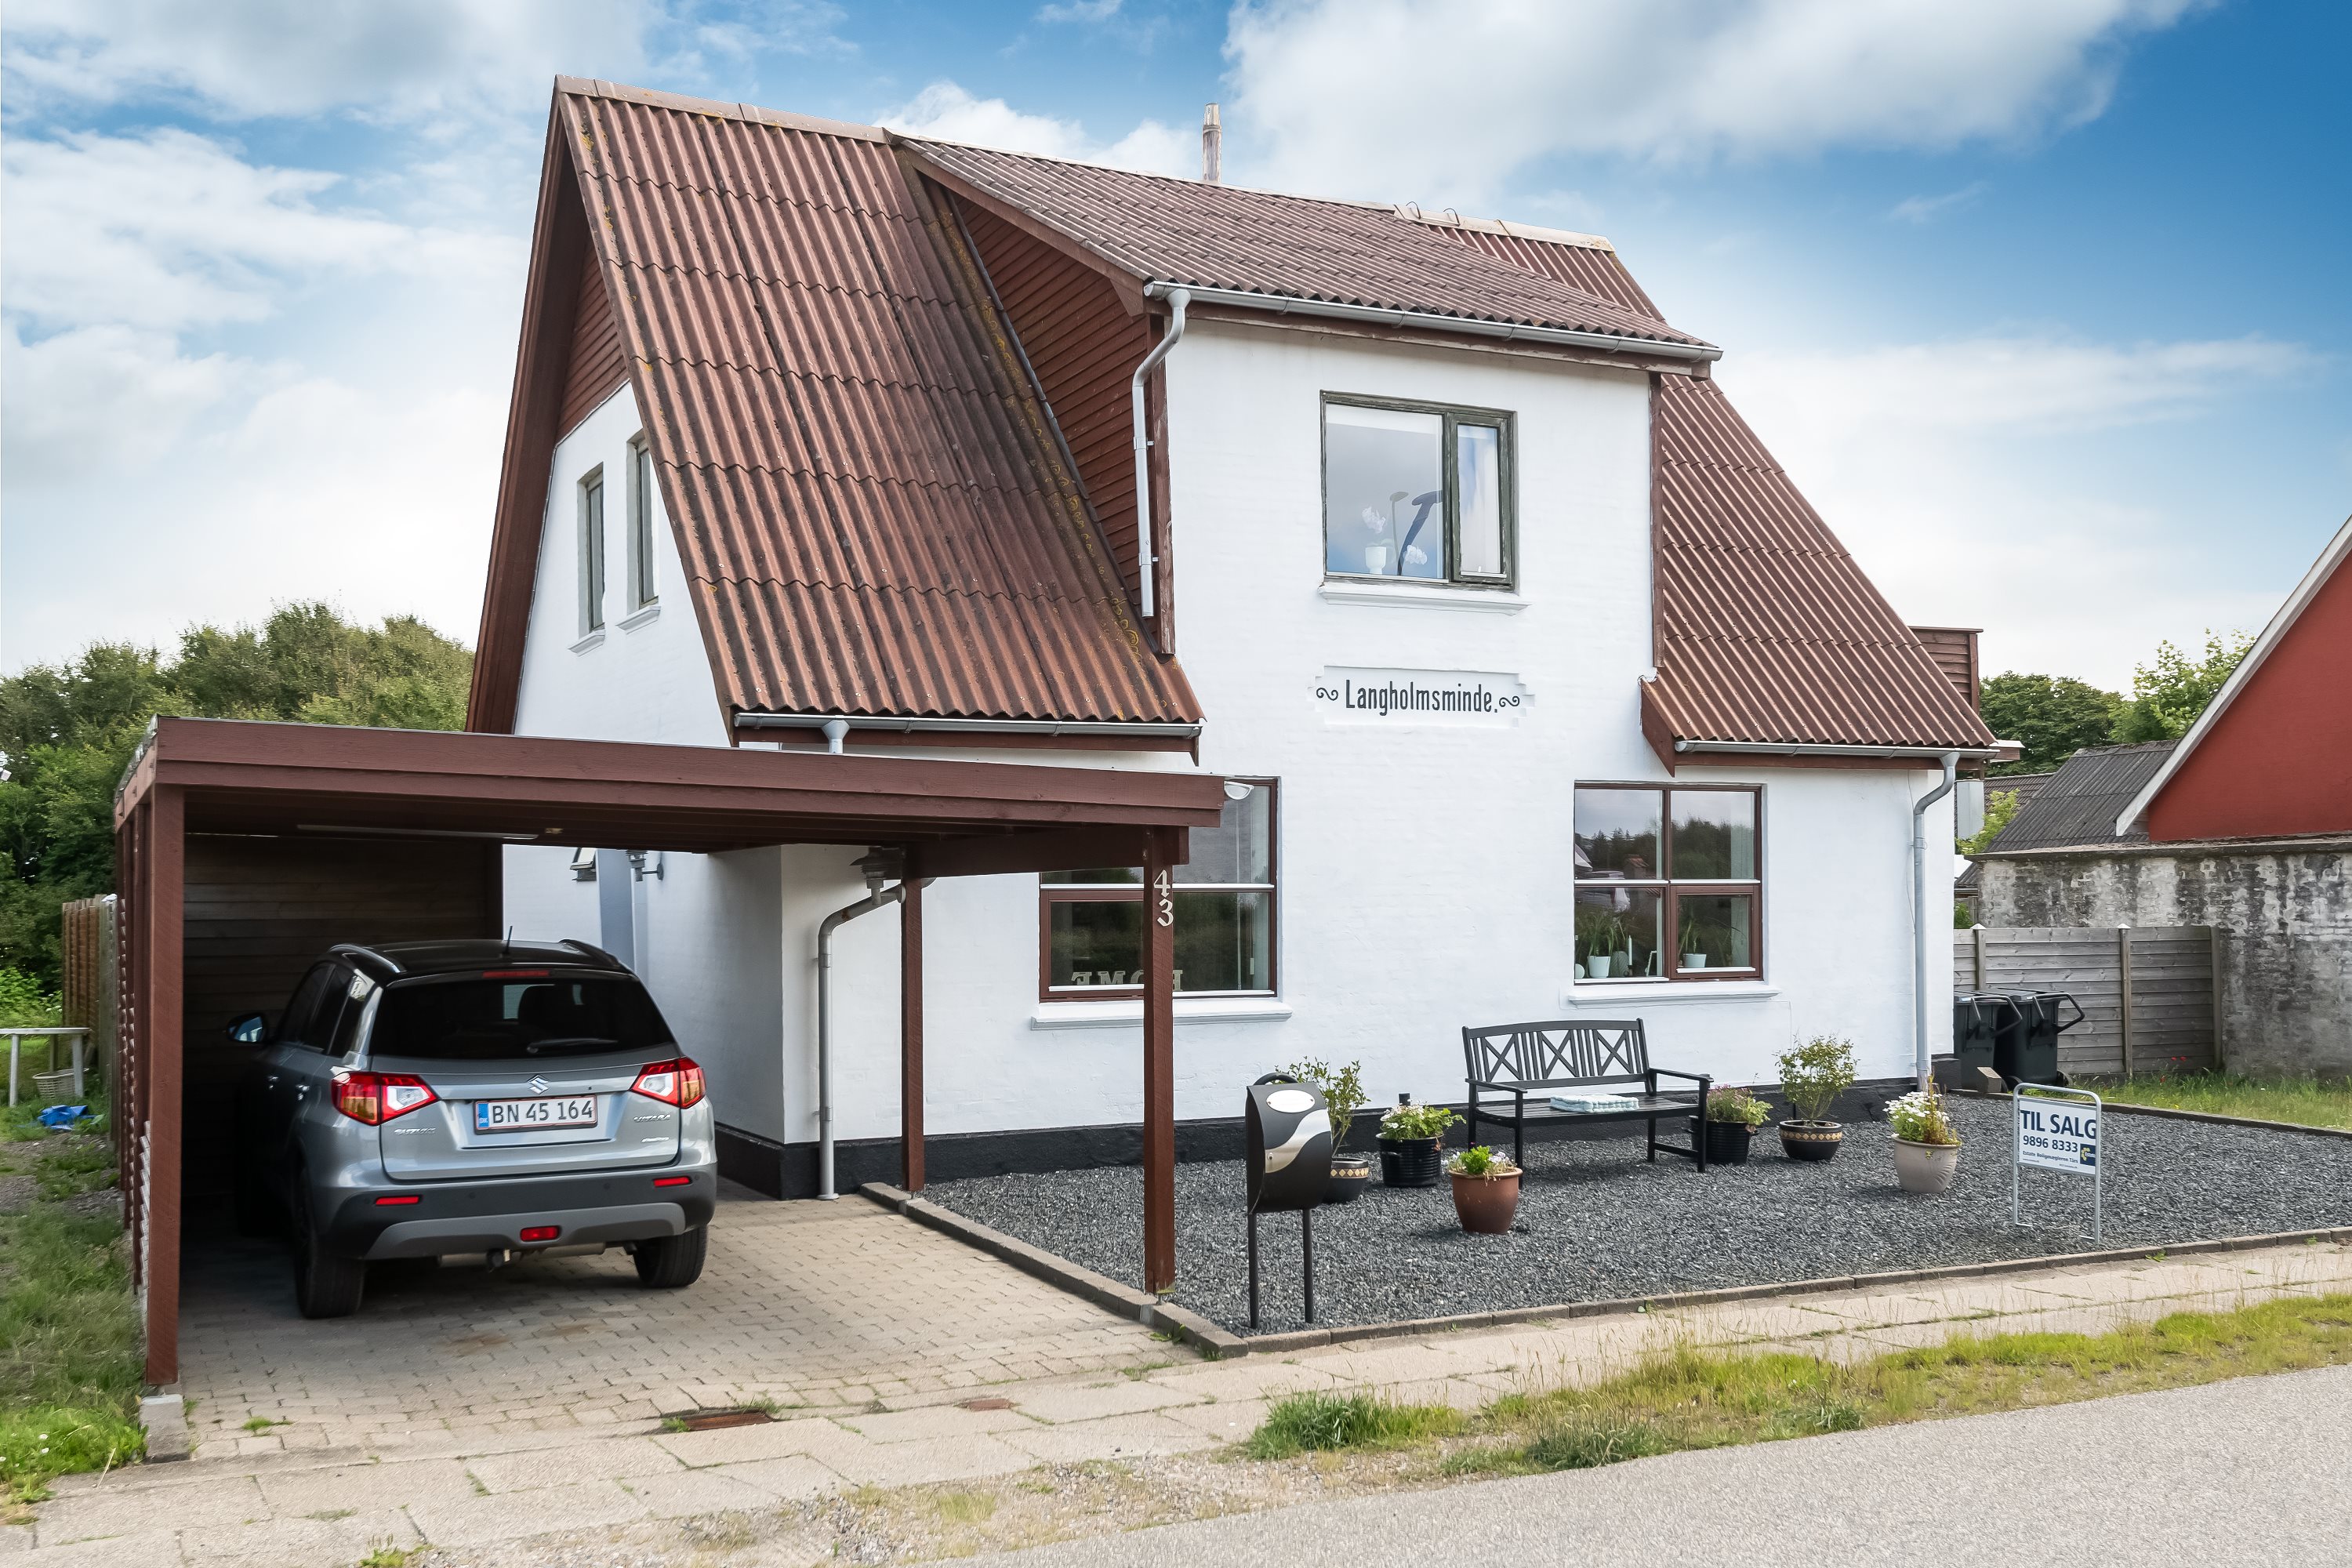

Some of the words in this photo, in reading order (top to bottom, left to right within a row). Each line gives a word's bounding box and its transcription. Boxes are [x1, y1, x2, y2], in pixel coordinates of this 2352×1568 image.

[1345, 679, 1498, 717] Langholmsminde.
[1153, 869, 1174, 927] 43
[492, 1104, 519, 1123] BN
[526, 1102, 550, 1121] 45
[557, 1100, 593, 1120] 164
[2020, 1109, 2045, 1132] TIL
[2050, 1113, 2096, 1140] SALG
[2023, 1135, 2049, 1149] 9896
[2052, 1139, 2078, 1153] 8333
